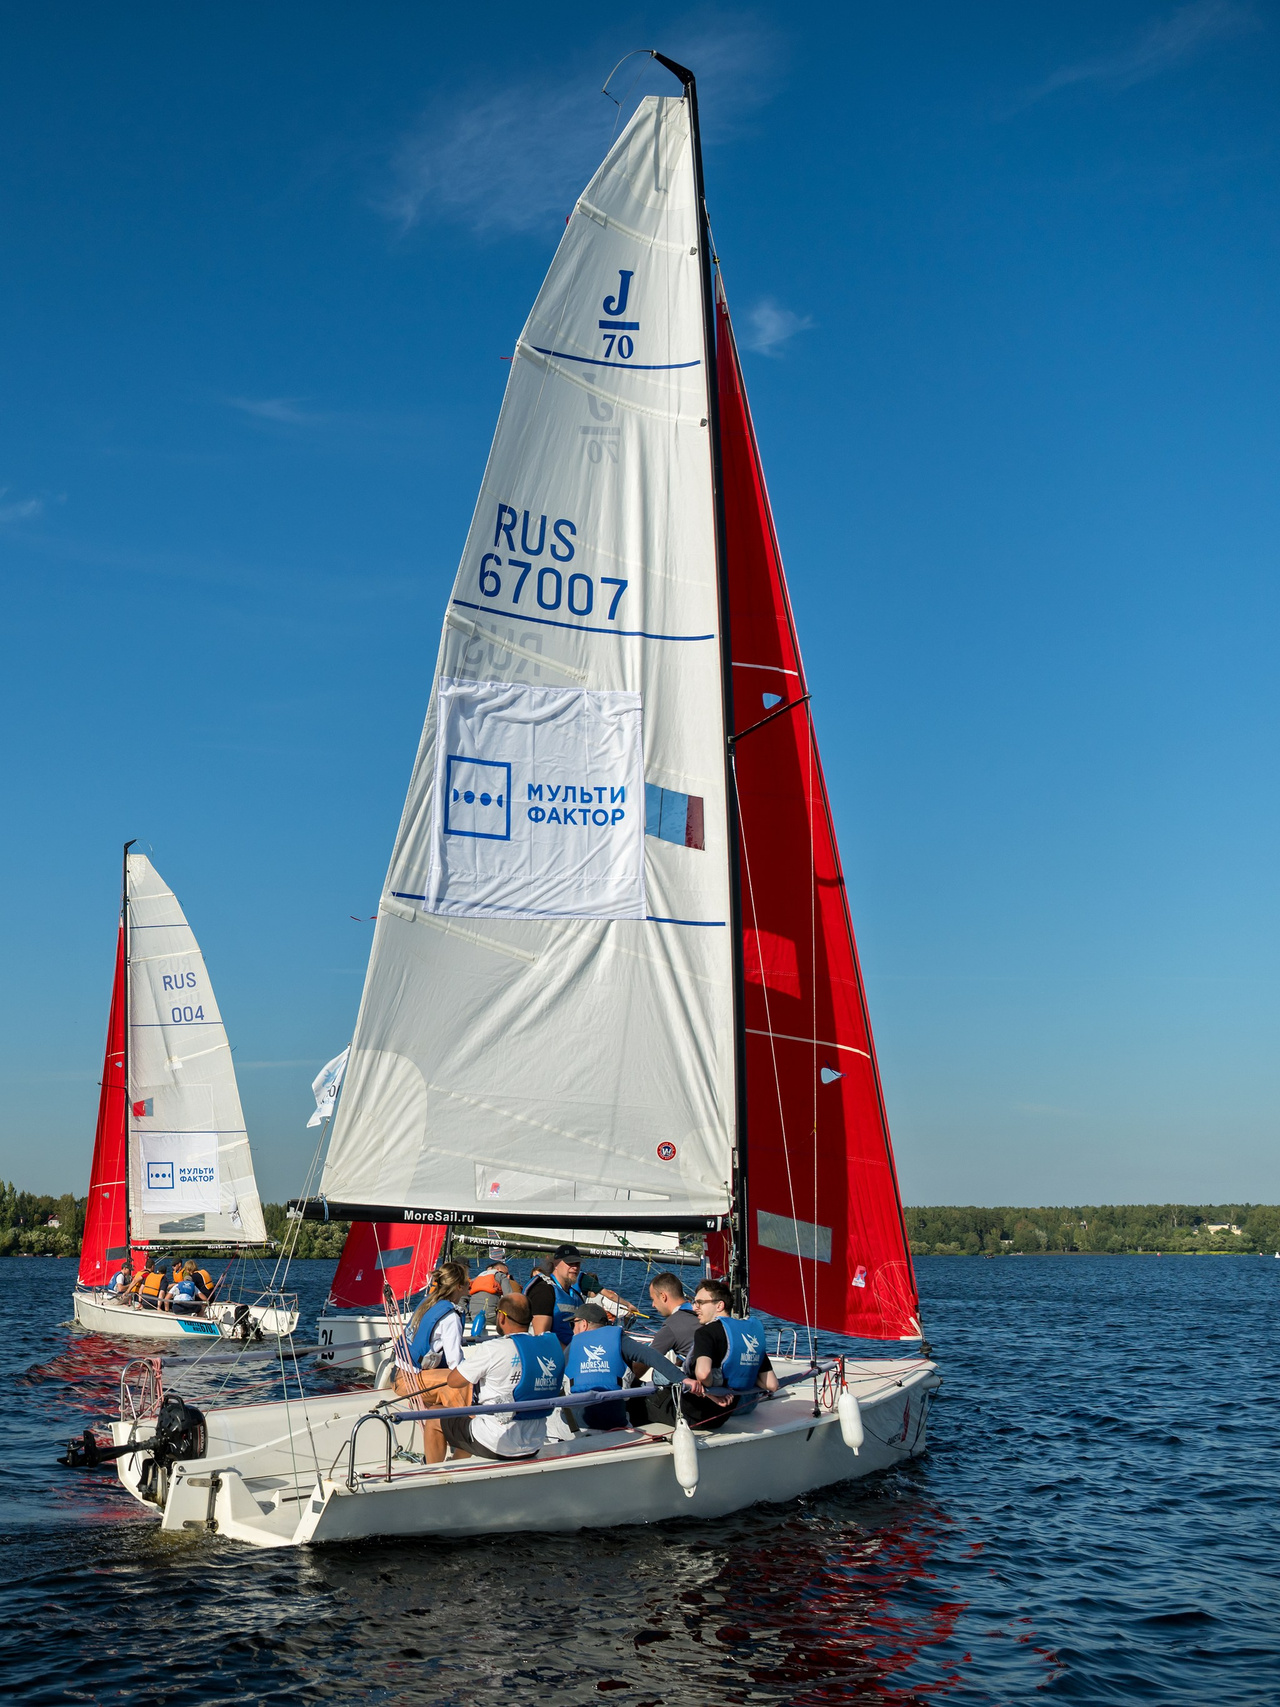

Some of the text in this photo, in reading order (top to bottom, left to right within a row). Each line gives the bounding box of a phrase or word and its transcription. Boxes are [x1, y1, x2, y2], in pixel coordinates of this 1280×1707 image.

[602, 269, 635, 316] J
[602, 333, 634, 360] 70
[494, 502, 577, 563] RUS
[478, 552, 629, 621] 67007
[527, 783, 626, 804] МУЛЬТИ
[527, 805, 626, 827] ФАКТОР
[162, 971, 197, 991] RUS
[171, 1005, 205, 1023] 004
[179, 1167, 214, 1175] МУЛЬТИ
[179, 1175, 214, 1183] ФАКТОР
[403, 1209, 475, 1223] MoreSail.ru
[580, 1360, 610, 1370] MORESAIL
[175, 1475, 184, 1486] 7
